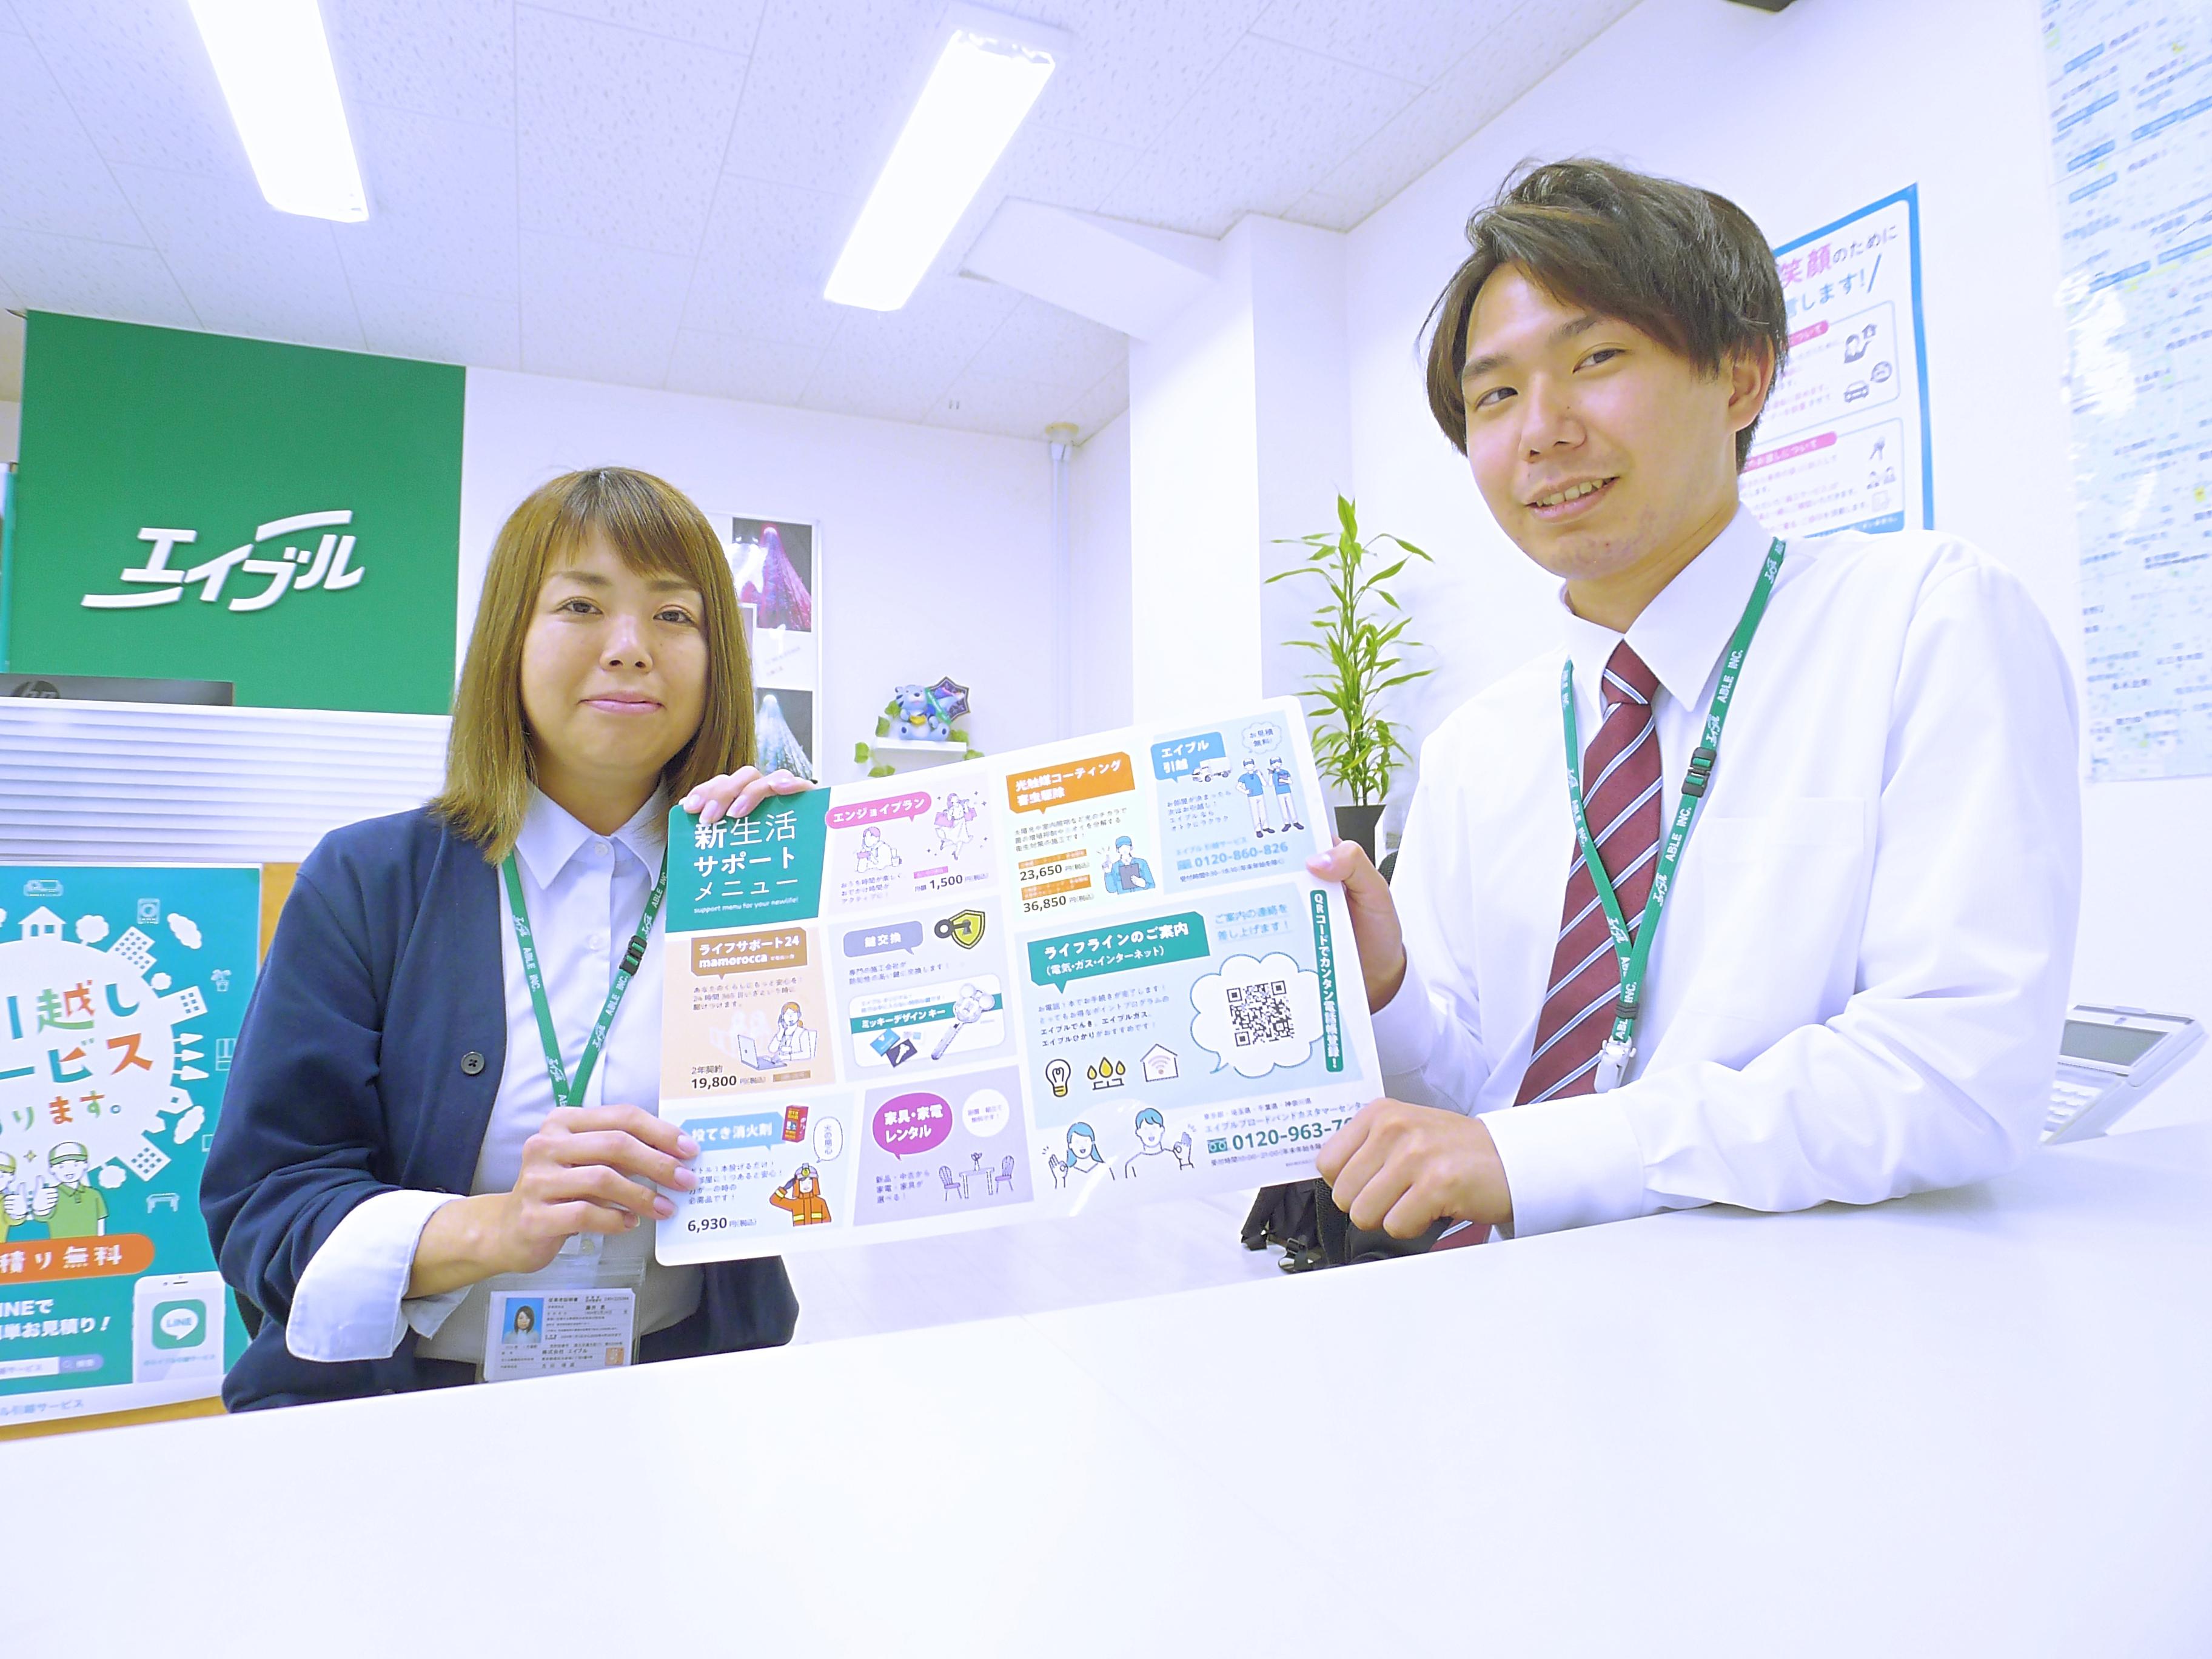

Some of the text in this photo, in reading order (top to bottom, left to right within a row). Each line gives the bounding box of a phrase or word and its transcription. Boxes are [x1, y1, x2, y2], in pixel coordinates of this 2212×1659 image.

[1780, 224, 1898, 290] 笑顔のために
[1786, 268, 1865, 319] します!
[81, 511, 365, 611] エイブル
[1717, 649, 1744, 704] ABLE INC.
[1161, 739, 1210, 758] エイブル
[833, 797, 925, 823] エンジョイプラン
[694, 810, 797, 850] 新生活
[1664, 806, 1693, 862] ABLE INC.
[694, 846, 795, 877] サポート
[1195, 841, 1289, 868] 0120-860-826
[929, 874, 964, 892] 1,500
[1019, 863, 1062, 882] 23,650
[651, 886, 663, 909] ABLE
[695, 879, 798, 901] メニュー
[694, 905, 721, 914] support
[754, 900, 770, 909] your
[1023, 895, 1067, 913] 36,850
[699, 935, 800, 956] ライフサポート24
[1044, 922, 1189, 960] ライフラインのご案内
[523, 947, 541, 993] ABLE INC.
[699, 954, 768, 968] mamorocca
[605, 974, 630, 1016] ABLE INC.
[1615, 981, 1637, 1040] ABL INC.
[691, 1065, 723, 1074] 2年契約
[691, 1075, 737, 1090] 19,800
[883, 1104, 943, 1125] 家具・家電
[691, 1122, 773, 1142] 投てき消火剤
[885, 1124, 932, 1144] レンタル
[1232, 1116, 1353, 1151] 0120-963-7
[687, 1217, 728, 1233] 6,930
[166, 1317, 192, 1328] LINE
